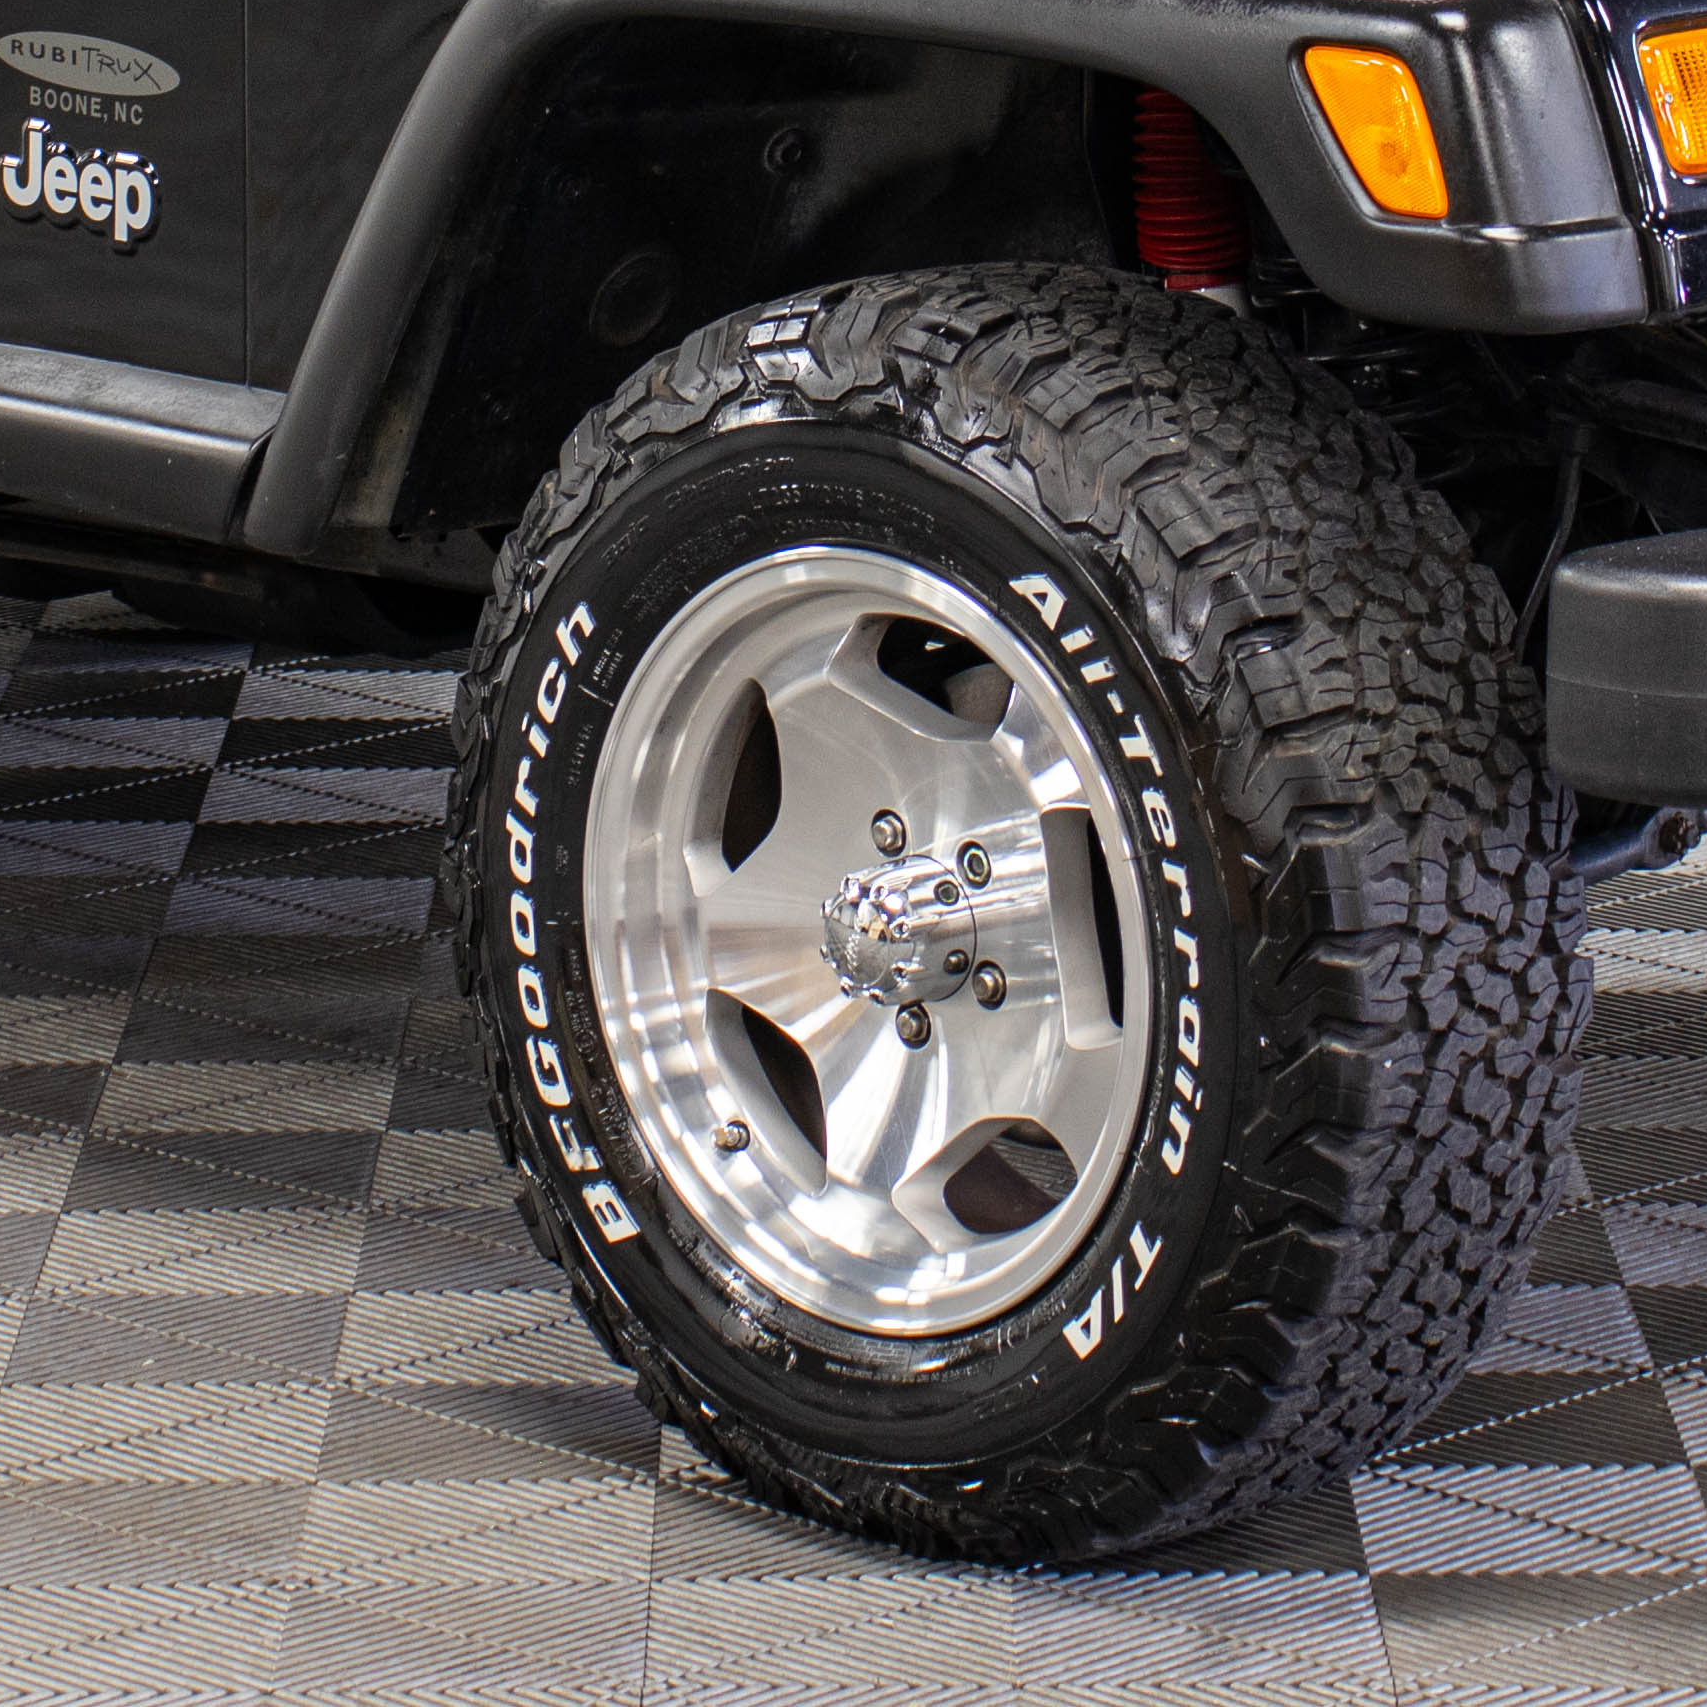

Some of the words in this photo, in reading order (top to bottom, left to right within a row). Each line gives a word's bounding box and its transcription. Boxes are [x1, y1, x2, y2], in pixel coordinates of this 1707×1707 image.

[10, 39, 162, 91] RUBITRUX
[29, 85, 109, 125] BOONE,
[114, 100, 143, 126] NC
[506, 600, 642, 1244] BFGoodrich
[1009, 573, 1205, 1176] All-Terrain
[1062, 1221, 1164, 1360] T/A
